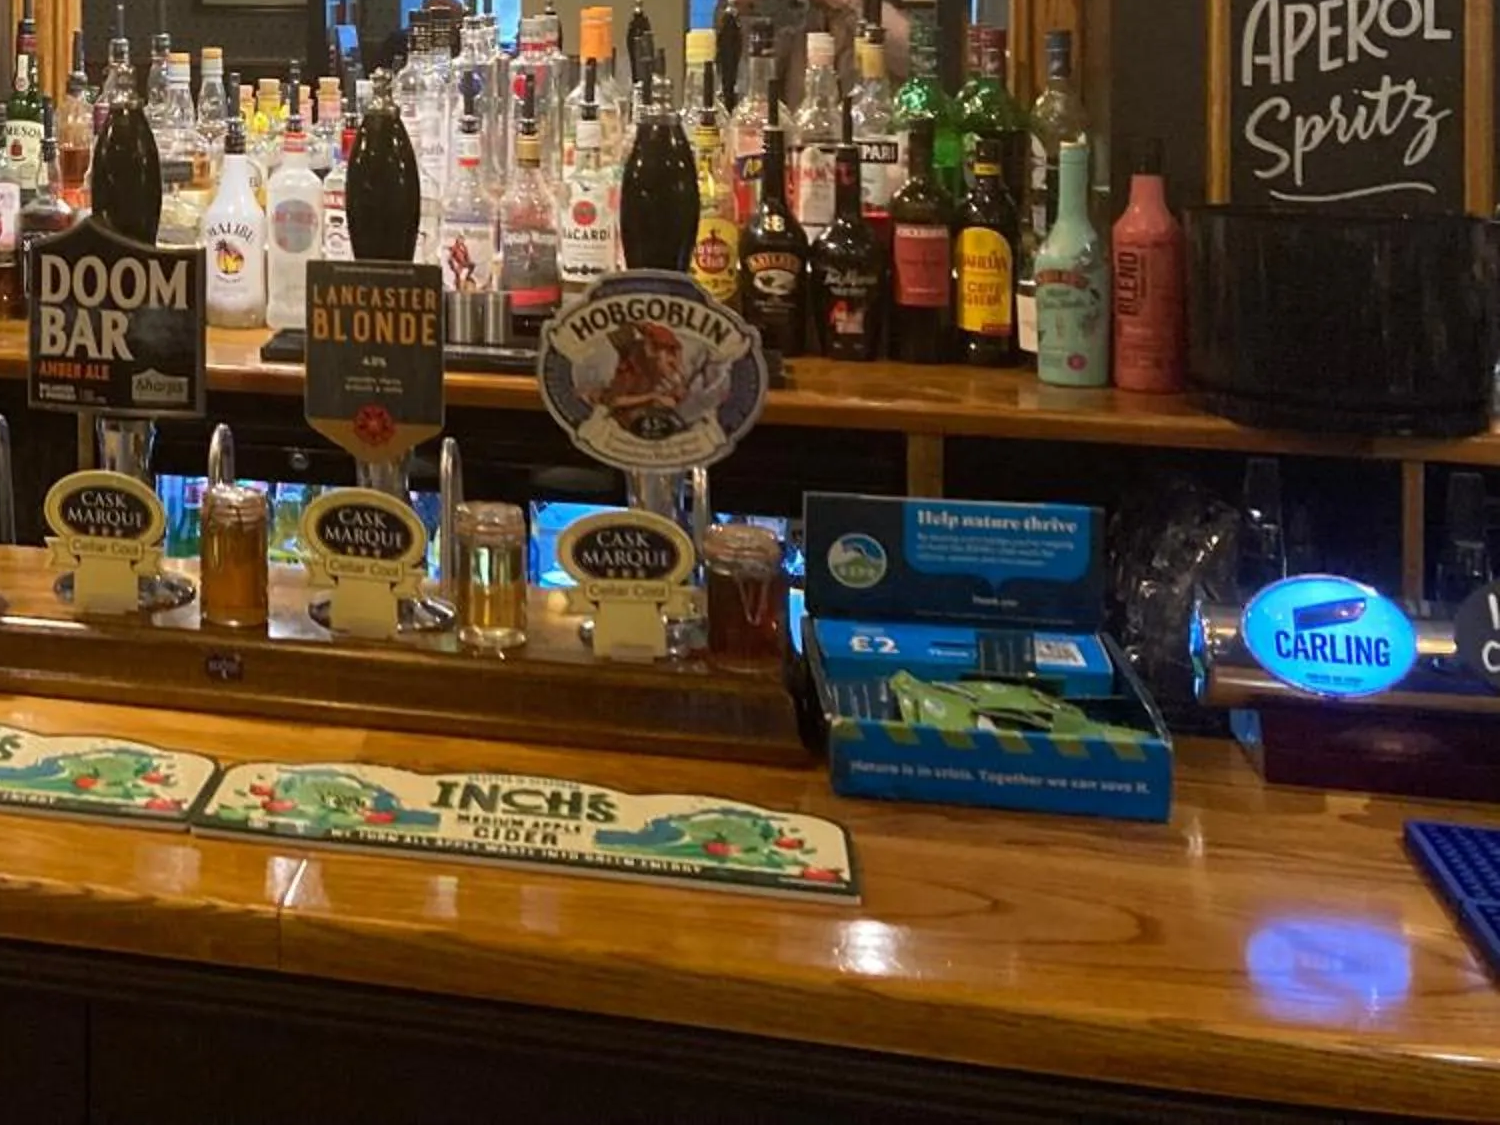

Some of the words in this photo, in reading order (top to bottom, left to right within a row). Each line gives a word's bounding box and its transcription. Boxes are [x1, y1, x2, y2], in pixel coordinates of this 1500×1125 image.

[1245, 74, 1453, 187] Spritz
[861, 142, 896, 161] PARI
[41, 254, 189, 310] DOOM
[312, 283, 438, 313] LANCASTER
[312, 309, 438, 347] BLONDE
[569, 298, 733, 346] HOBGOBLIN
[39, 306, 134, 362] BAR
[84, 362, 111, 381] ALE
[81, 491, 128, 510] CASK
[66, 507, 143, 528] MARQUE
[338, 510, 388, 530] CASK
[917, 509, 959, 531] Help
[962, 515, 1020, 532] nature
[1022, 515, 1078, 535] thrive
[325, 526, 403, 550] MARQUE
[596, 530, 651, 551] CASK
[581, 548, 669, 570] MARQUE
[1274, 630, 1391, 668] CARLING
[977, 770, 1043, 787] Together
[472, 826, 559, 846] CIDER
[531, 818, 582, 835] APPLE
